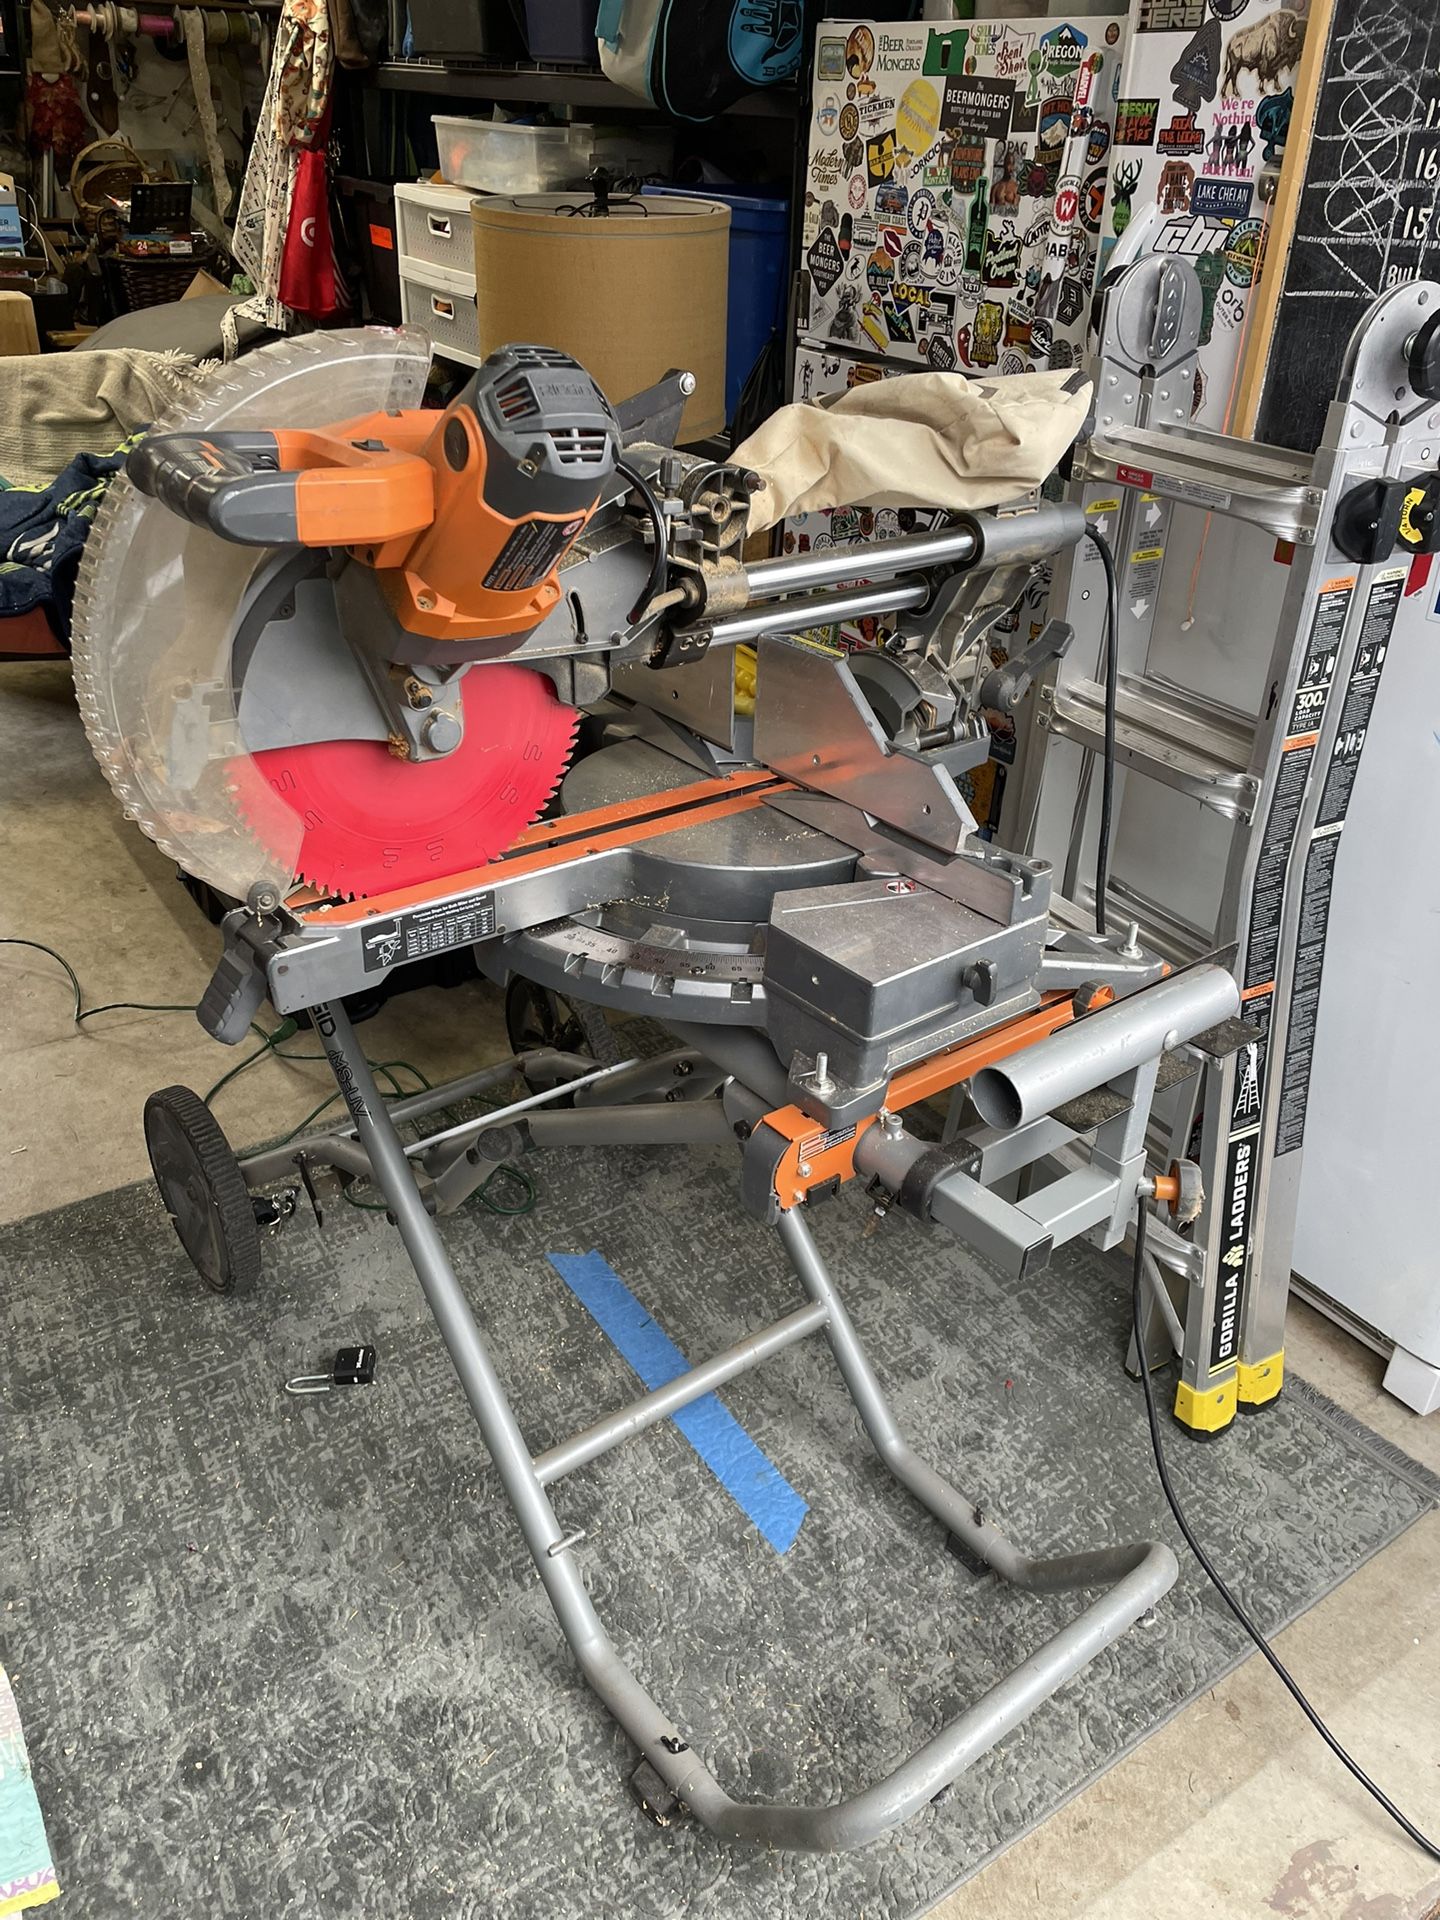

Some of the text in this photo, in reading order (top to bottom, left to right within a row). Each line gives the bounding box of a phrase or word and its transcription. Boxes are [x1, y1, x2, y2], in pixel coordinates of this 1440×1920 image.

[1137, 7, 1203, 29] HERB
[883, 35, 904, 51] BEER
[876, 54, 921, 72] MONGERS
[859, 98, 896, 116] TICKMEN
[946, 89, 1011, 110] BEERMONGERS
[1221, 99, 1254, 111] We're
[1212, 111, 1257, 128] Nothing
[1415, 148, 1438, 178] 16
[811, 166, 838, 185] Times
[924, 176, 949, 185] MONTANA
[1197, 184, 1249, 202] LAKE CHELAN
[1060, 197, 1075, 217] W
[1403, 206, 1432, 240] 15
[137, 242, 148, 251] 24
[818, 242, 835, 257] BEER
[809, 254, 840, 273] MONGERS
[985, 246, 1018, 268] Portland
[940, 268, 956, 282] GIN
[990, 261, 1016, 279] Oregon
[893, 281, 932, 308] LOCAL
[964, 282, 979, 292] YETI
[1401, 498, 1414, 520] TURN
[1296, 690, 1323, 710] 300
[1294, 711, 1321, 722] CAPACITY
[1295, 708, 1311, 716] LOAD
[1292, 721, 1307, 731] TYPE
[312, 1002, 337, 1037] GID
[1219, 1143, 1251, 1358] GORILLA LADDERS
